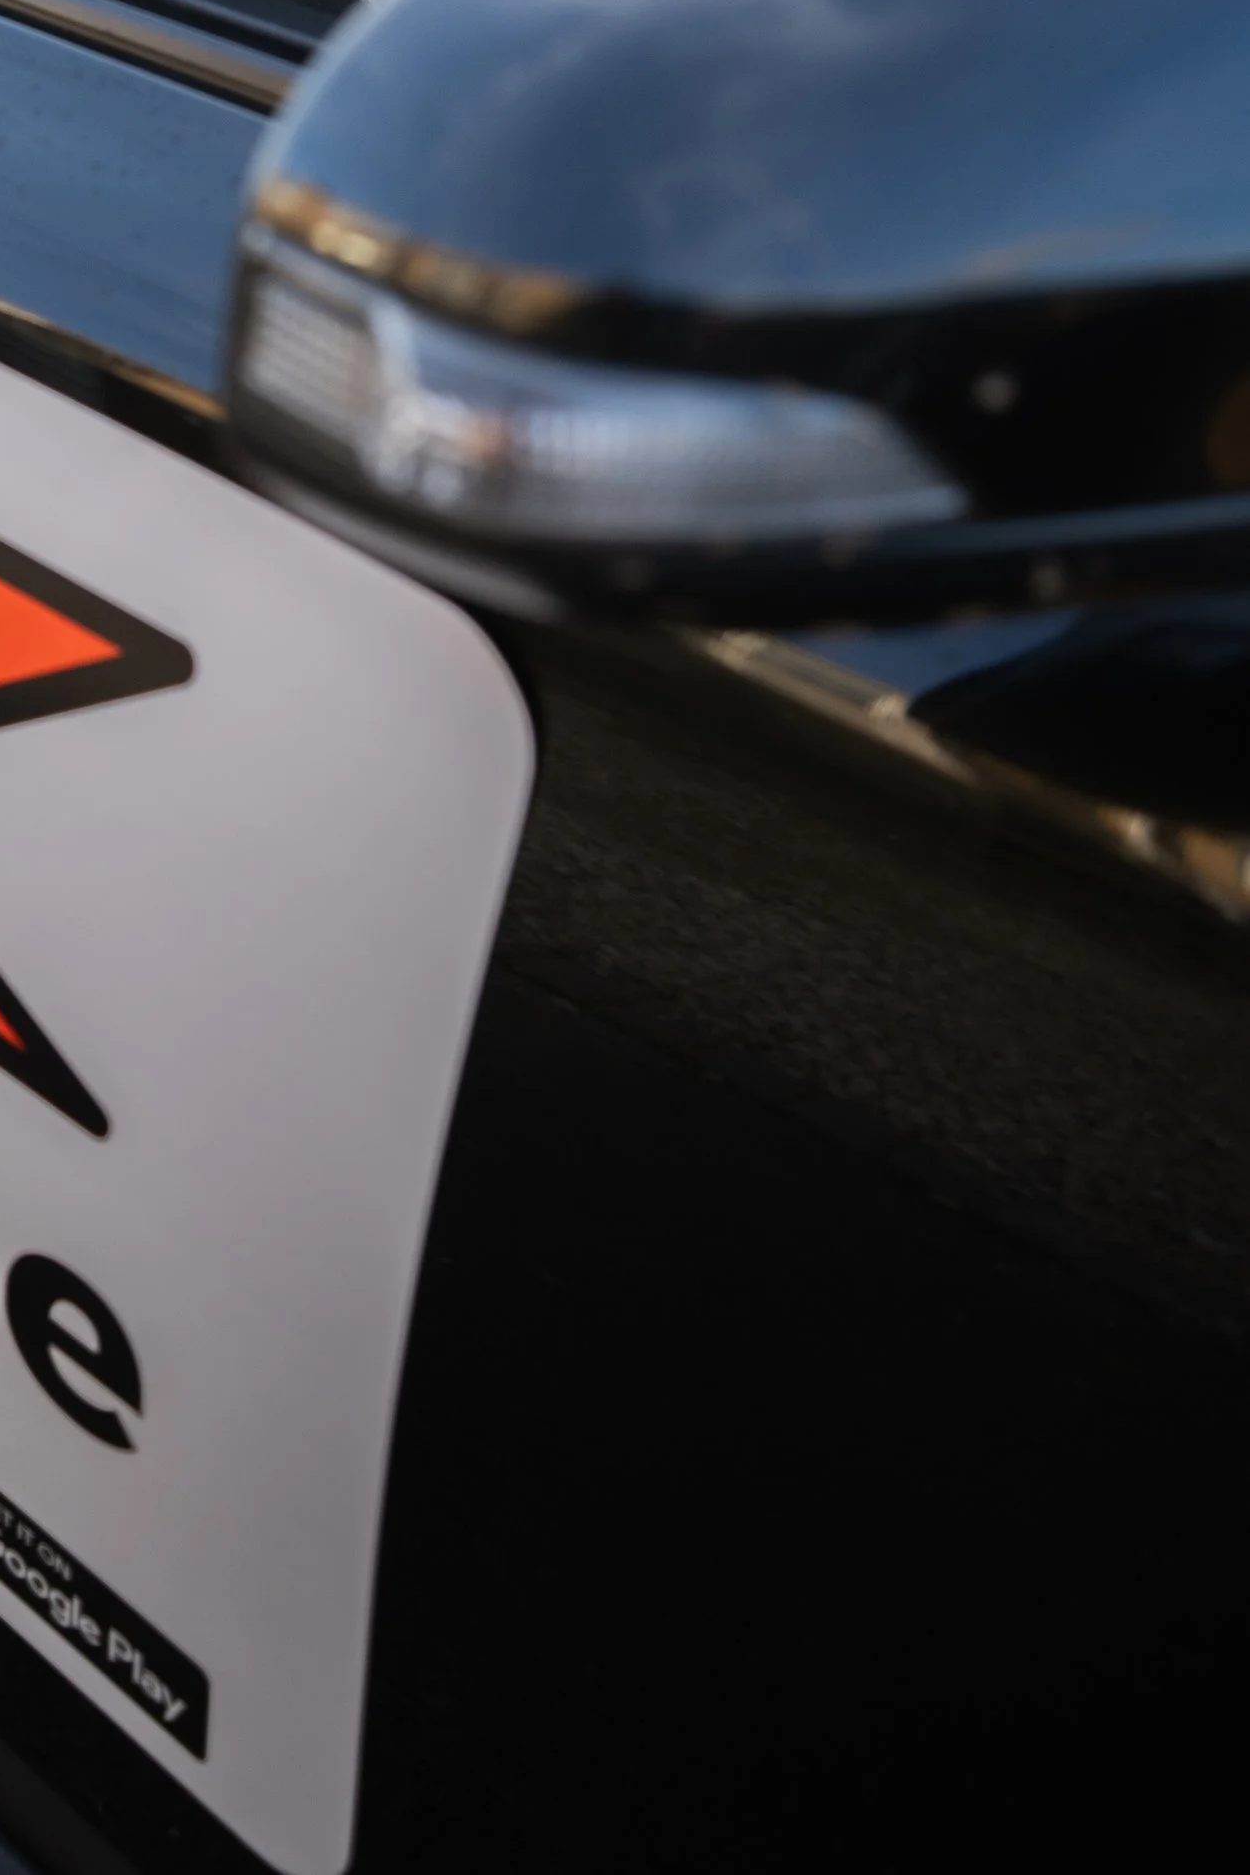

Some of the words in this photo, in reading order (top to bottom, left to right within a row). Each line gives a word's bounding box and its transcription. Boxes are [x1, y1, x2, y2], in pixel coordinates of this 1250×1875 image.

[16, 1522, 35, 1547] IT
[37, 1542, 72, 1580] ON
[107, 1627, 187, 1722] Play
